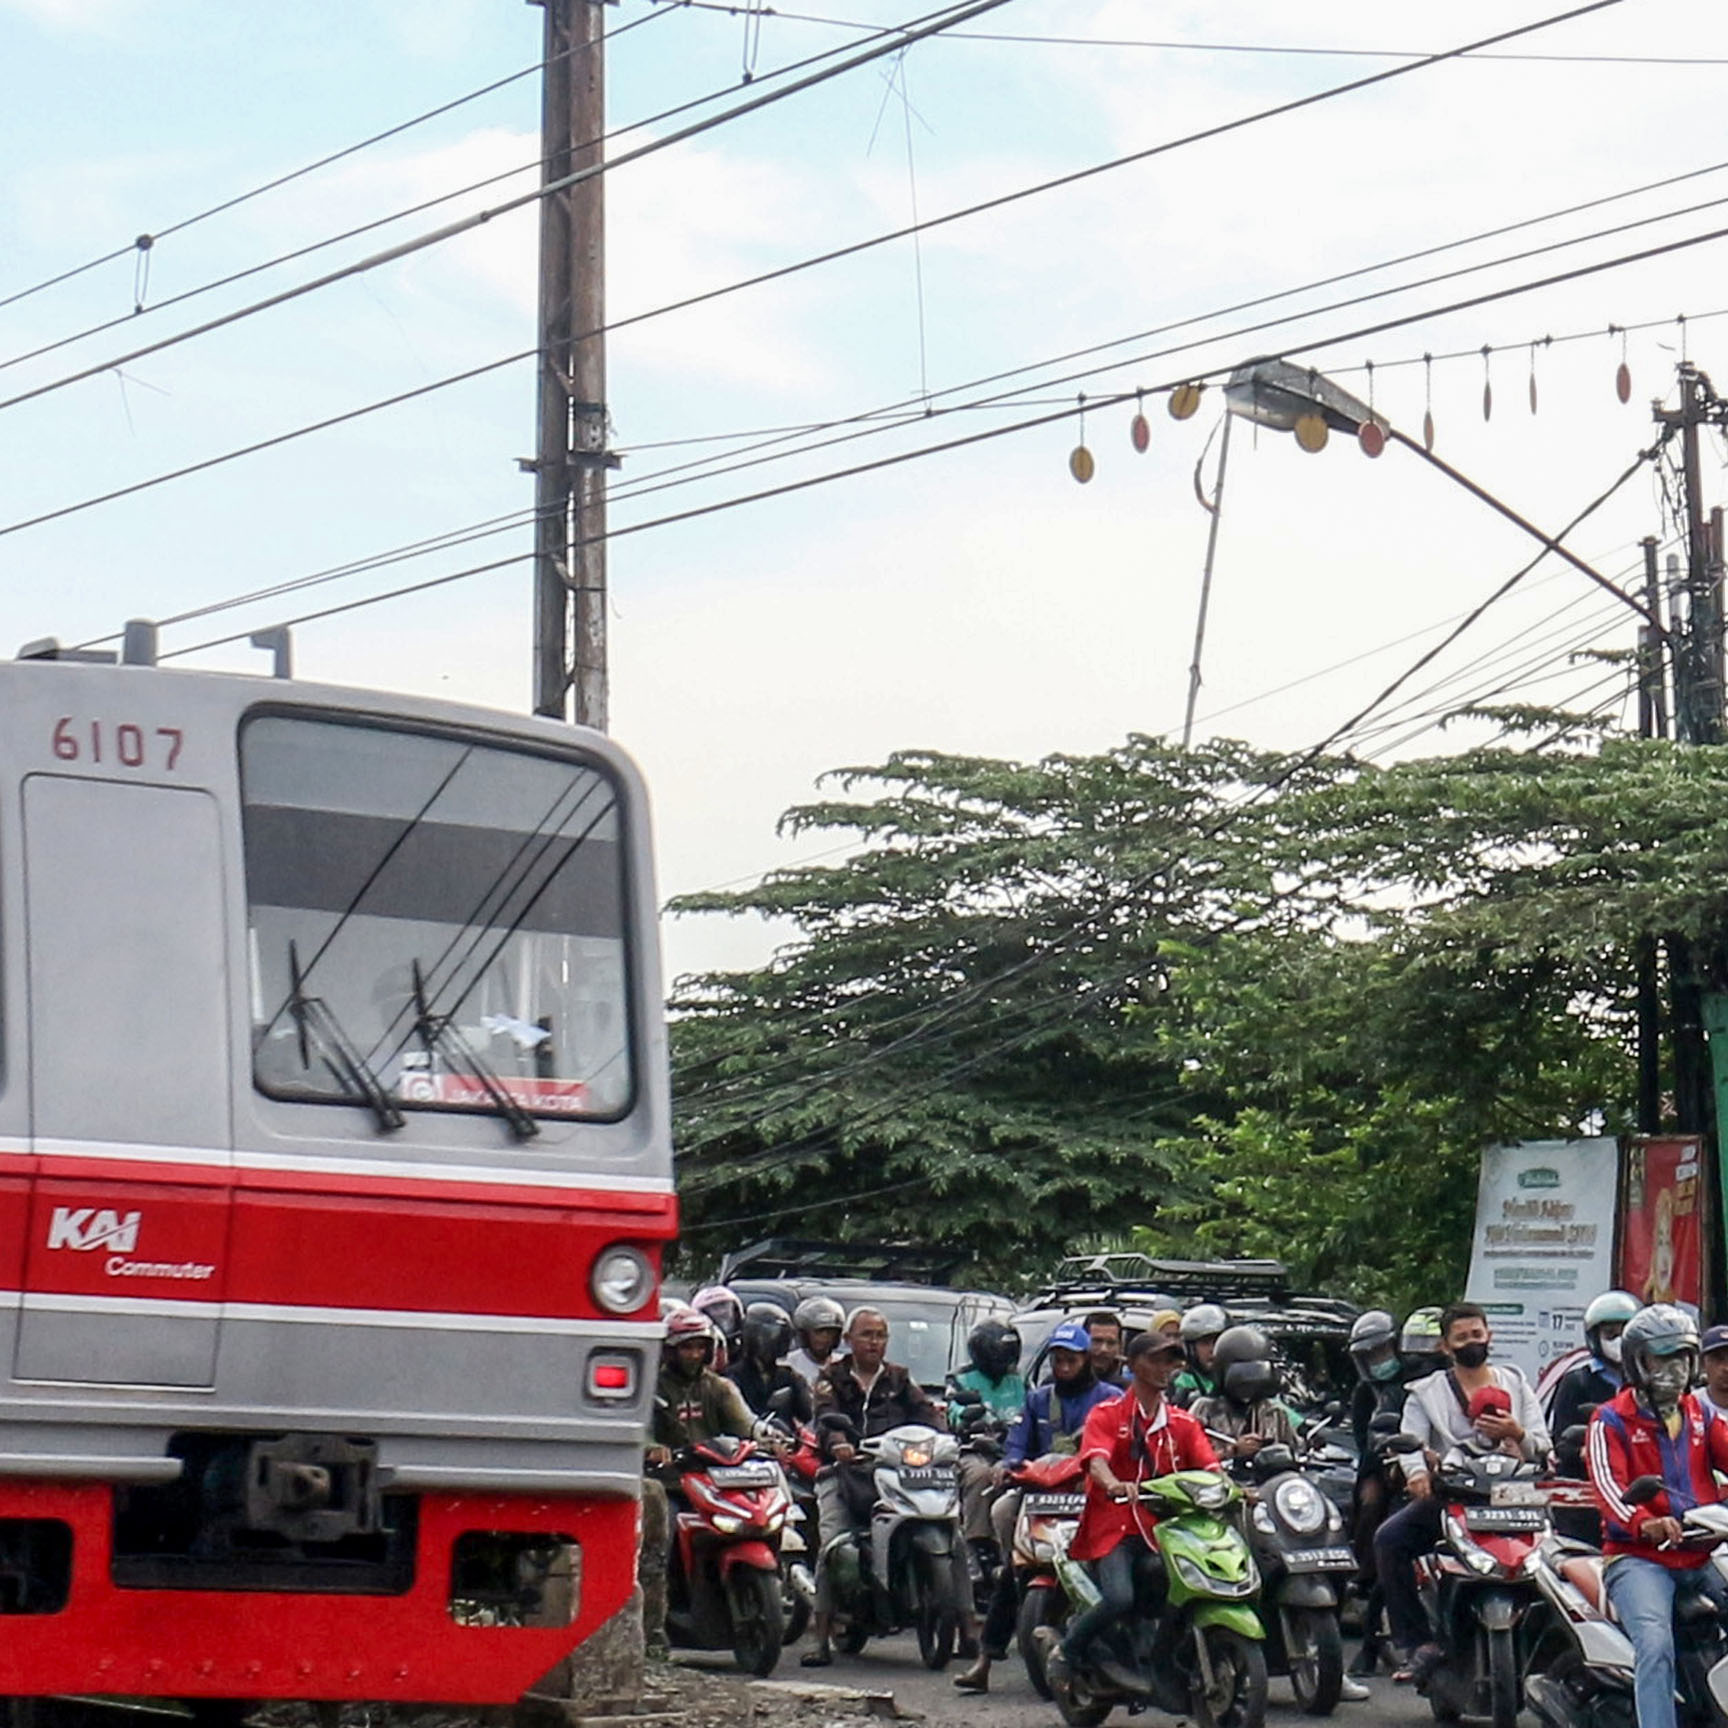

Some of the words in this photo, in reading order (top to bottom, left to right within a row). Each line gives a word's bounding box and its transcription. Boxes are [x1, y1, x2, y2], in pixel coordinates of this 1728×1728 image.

[53, 717, 183, 771] 6107
[47, 1207, 142, 1252] KAI
[105, 1256, 215, 1279] Commuter
